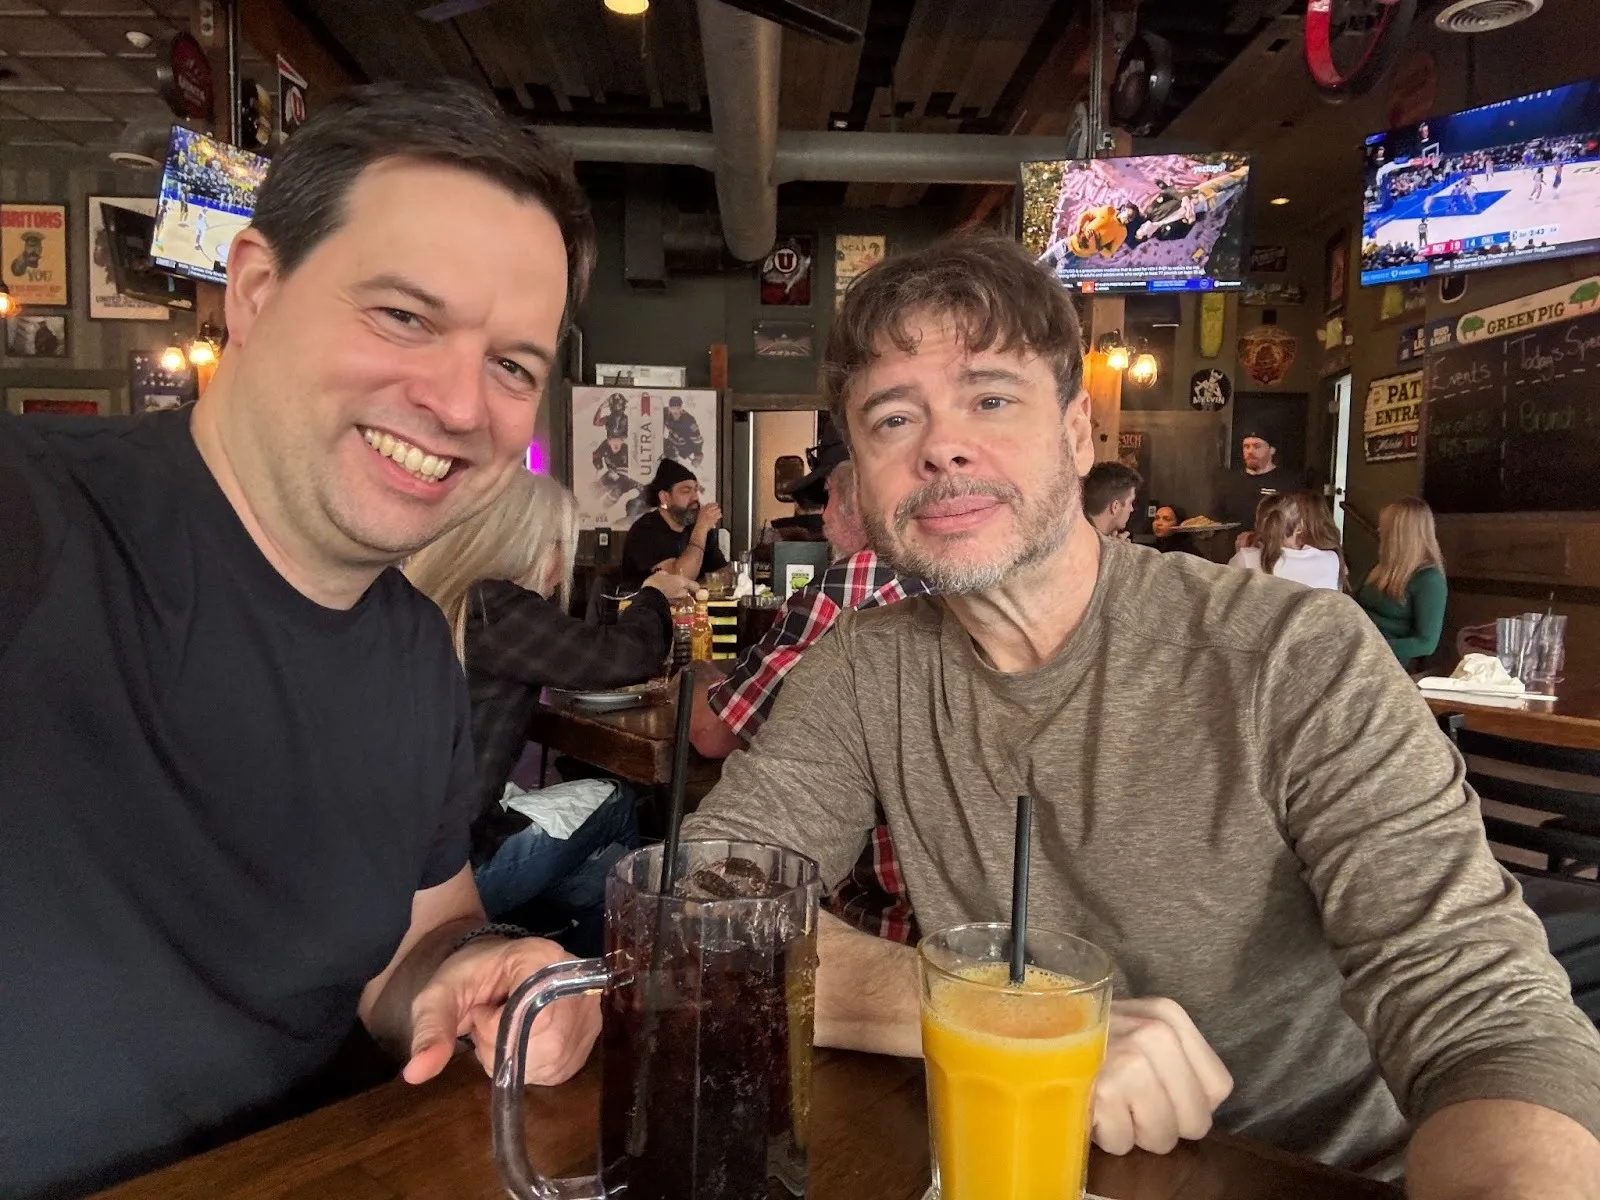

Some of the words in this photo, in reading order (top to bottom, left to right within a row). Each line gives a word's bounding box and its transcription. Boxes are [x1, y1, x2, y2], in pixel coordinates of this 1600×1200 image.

[1487, 309, 1536, 335] GREEN
[1538, 302, 1565, 322] PIG
[1193, 396, 1225, 405] MELVIN
[1387, 380, 1421, 404] PAT
[1375, 404, 1419, 426] ENTRA
[640, 422, 652, 476] ULTRA
